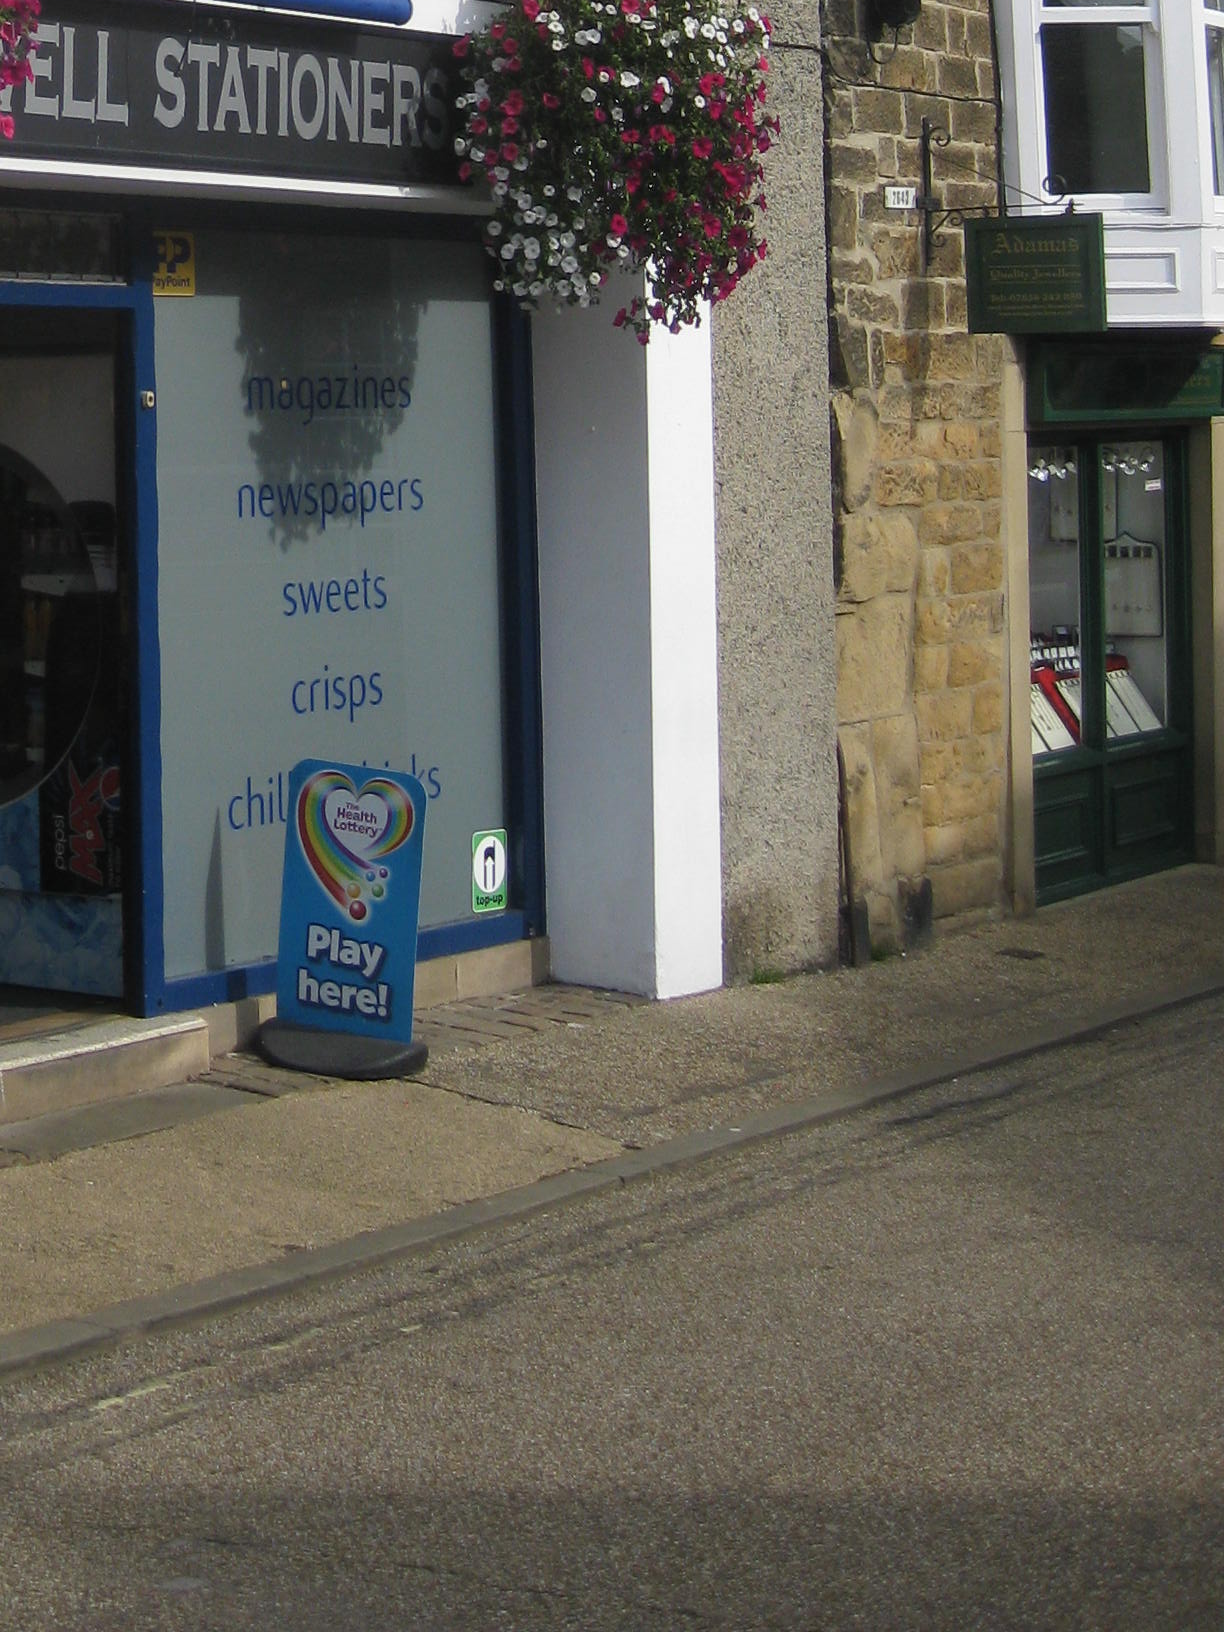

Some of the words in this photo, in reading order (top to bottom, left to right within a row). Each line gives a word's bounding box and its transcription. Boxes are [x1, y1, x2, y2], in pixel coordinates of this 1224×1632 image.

[153, 36, 450, 151] STATIONERS
[247, 364, 412, 426] magazines
[238, 478, 424, 530] newspapers
[283, 568, 388, 617] sweets
[291, 665, 384, 723] crisps
[228, 771, 291, 830] chil
[337, 806, 377, 825] Health
[345, 801, 360, 810] The
[54, 814, 67, 871] pepsi
[333, 818, 378, 839] Lottery
[475, 894, 504, 906] top-up
[307, 923, 384, 978] Play
[297, 967, 389, 1018] here!
